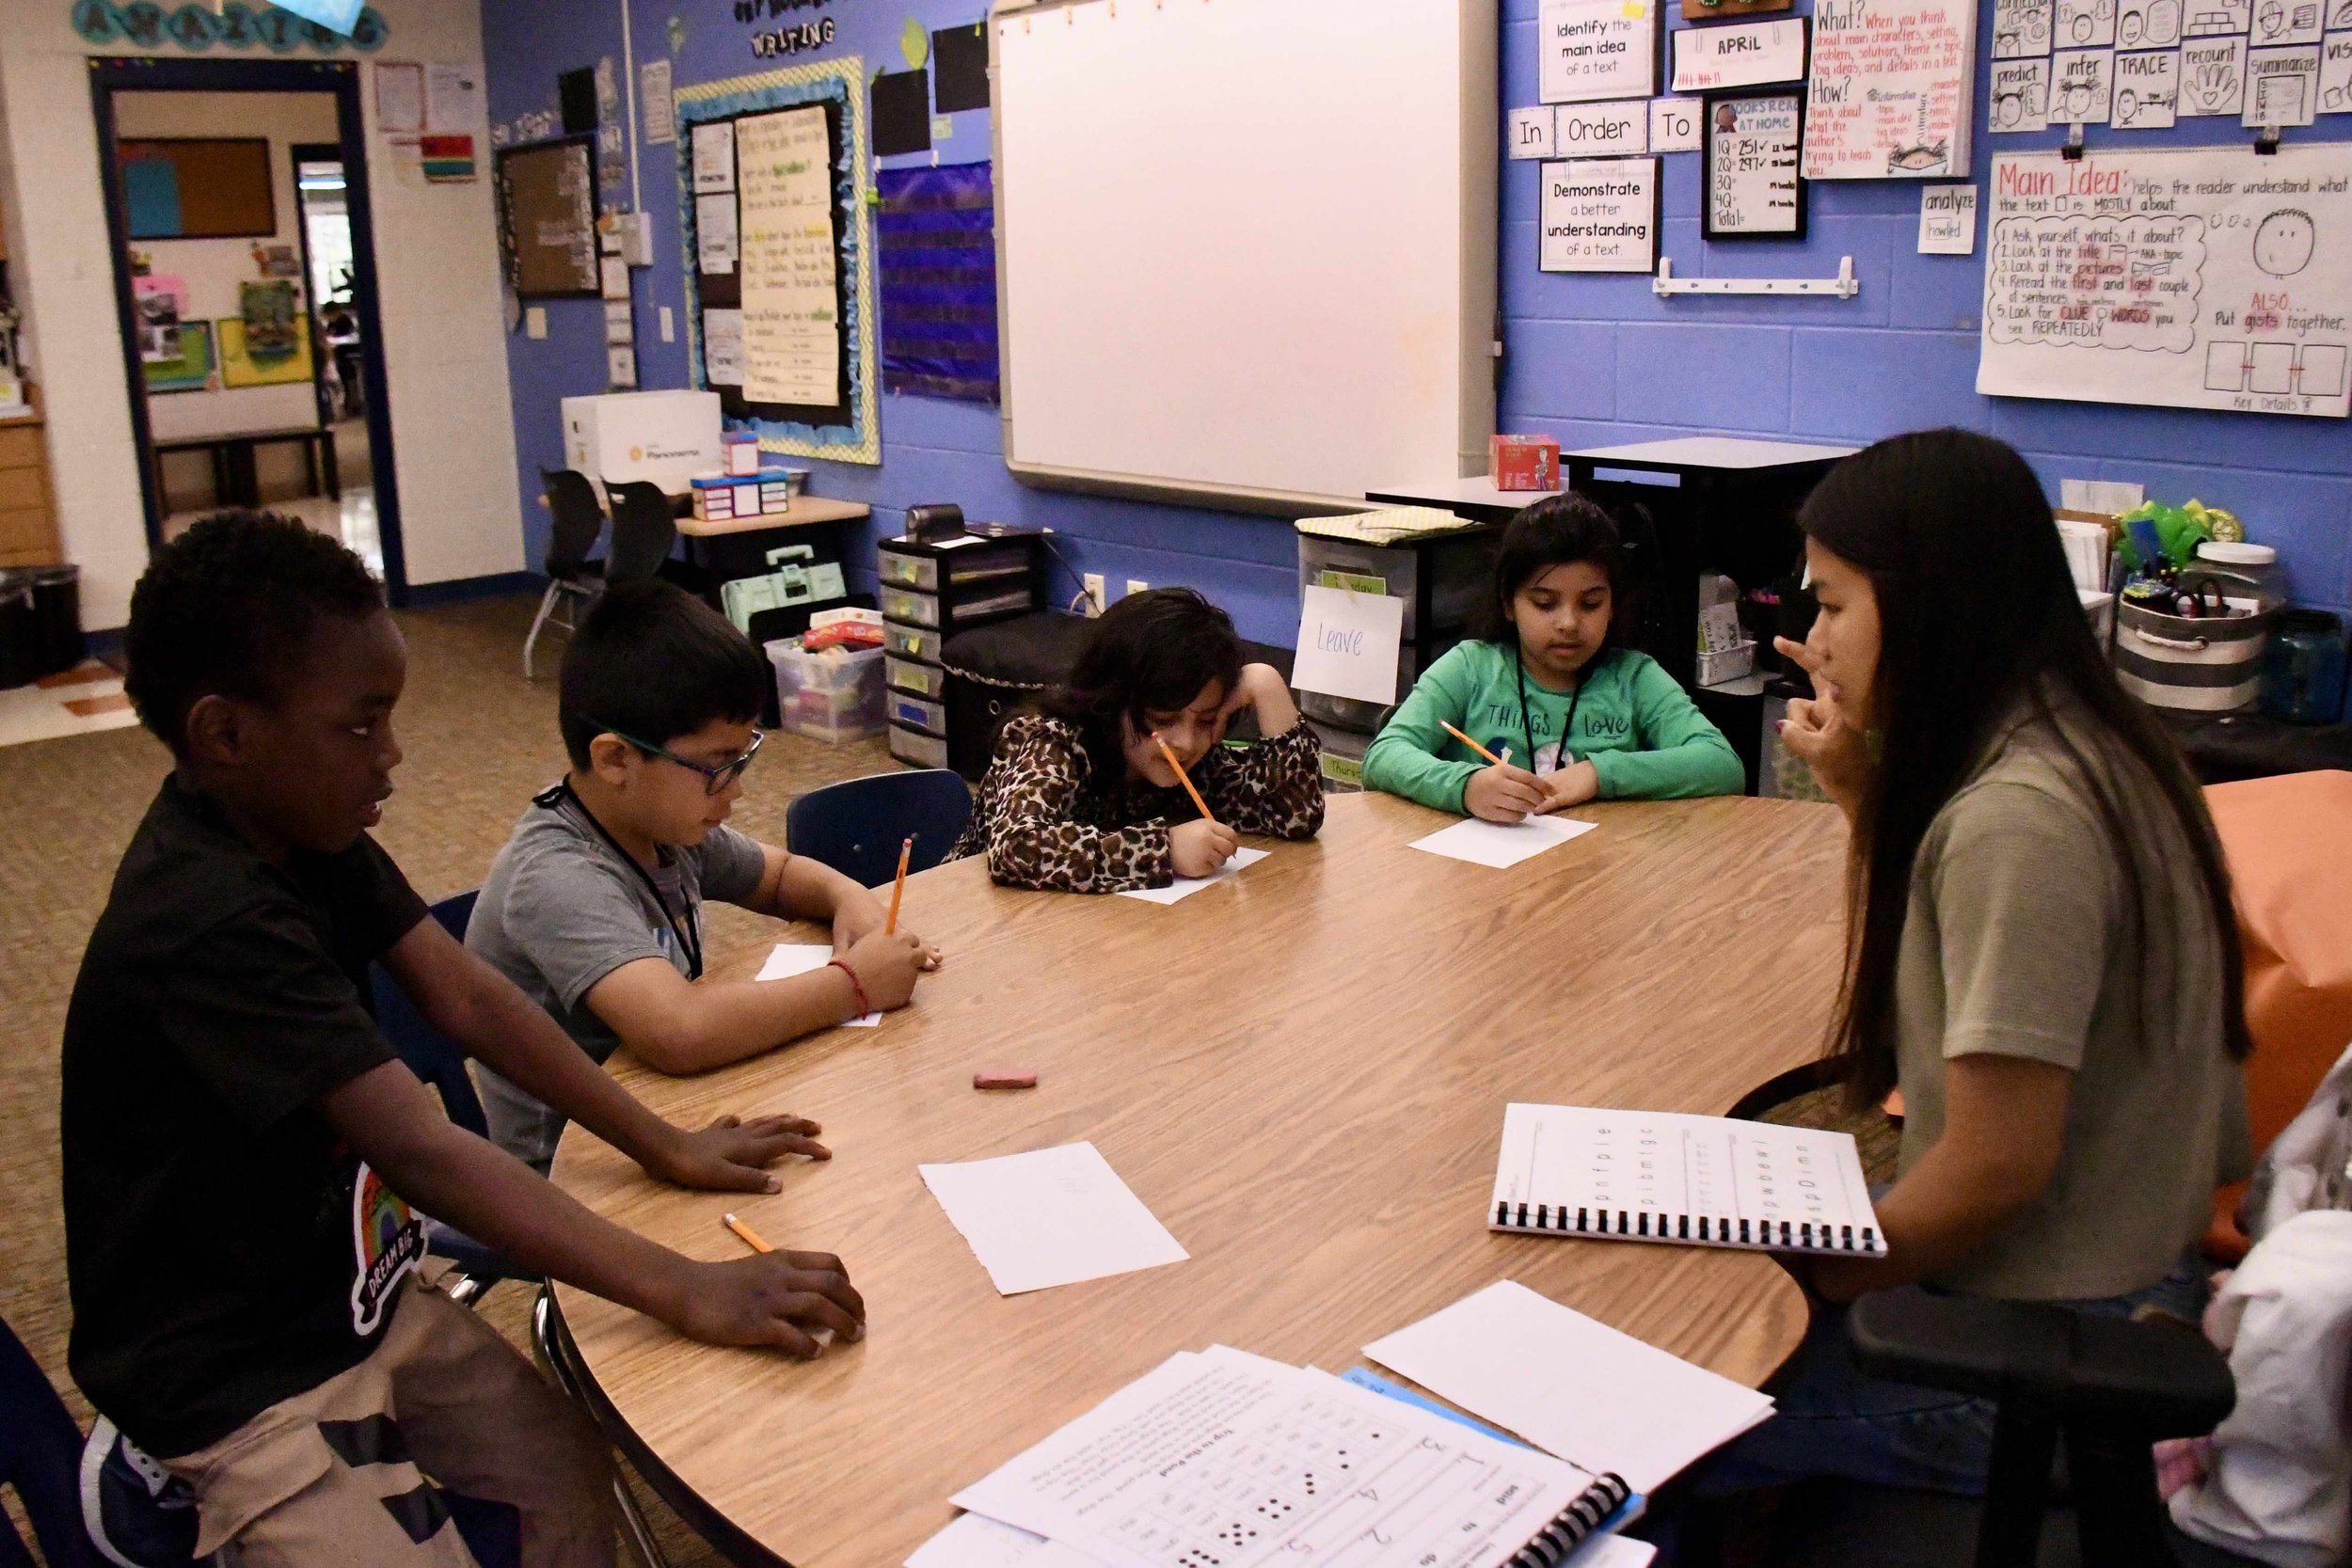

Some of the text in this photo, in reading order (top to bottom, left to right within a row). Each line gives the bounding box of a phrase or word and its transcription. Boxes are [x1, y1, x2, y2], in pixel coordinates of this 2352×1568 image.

[1818, 0, 1865, 32] What?
[1865, 9, 1947, 32] When you think
[751, 17, 835, 58] WRITING
[1557, 19, 1631, 38] Identify the
[1814, 31, 1840, 46] about
[1562, 40, 1626, 58] main idea
[2186, 41, 2236, 64] recount
[1565, 60, 1618, 75] of a text
[1816, 64, 1830, 81] big
[1865, 60, 1883, 73] and
[1887, 58, 1919, 72] details
[1921, 56, 1931, 66] in
[2066, 55, 2102, 77] infer
[2119, 55, 2169, 75] TRACE
[2250, 57, 2316, 75] summarize
[1997, 64, 2038, 88] predict
[1812, 75, 1851, 103] How?
[1808, 103, 1862, 119] Think about
[1520, 113, 1690, 145] In Order To
[1806, 119, 1846, 133] what the
[1804, 149, 1834, 166] trying
[1837, 150, 1846, 161] to
[1554, 181, 1641, 198] Demonstrate
[1999, 162, 2054, 197] Main
[2132, 177, 2163, 201] helps
[2172, 178, 2190, 196] the
[2196, 178, 2237, 196] reader
[2243, 177, 2311, 196] understand
[2318, 176, 2348, 194] what
[1571, 203, 1620, 216] a better
[1925, 188, 1974, 214] analyze
[2000, 196, 2177, 214] the text is MOSTLY about
[1548, 222, 1646, 239] understanding
[2011, 229, 2031, 243] Ask
[2127, 228, 2135, 243] it
[2143, 226, 2185, 243] about?
[1566, 243, 1579, 256] of
[1582, 245, 1591, 256] a
[2012, 245, 2035, 259] Look
[2040, 246, 2051, 258] at
[2056, 245, 2074, 258] the
[2010, 260, 2033, 273] Look
[2038, 261, 2049, 273] at
[2057, 261, 2073, 275] the
[2075, 261, 2124, 280] pictures
[2010, 275, 2045, 289] Reread
[2051, 276, 2068, 290] the
[2073, 277, 2098, 292] first
[2103, 277, 2124, 292] and
[2130, 277, 2153, 292] last
[2160, 278, 2189, 297] couple
[2009, 292, 2019, 303] of
[2009, 306, 2031, 319] Look
[2038, 307, 2053, 320] for
[2058, 307, 2090, 321] CLUE
[2109, 309, 2150, 322] WORDS
[2154, 314, 2174, 329] you
[2215, 310, 2346, 338] Put gists together.
[2032, 321, 2104, 337] REPEATEDLY
[2233, 397, 2297, 412] Key Details
[1317, 621, 1364, 657] Leave
[369, 1227, 414, 1298] DREAM BIG
[1159, 1428, 1234, 1477] Trip to the Pond
[1499, 1484, 1518, 1505] said
[1462, 1522, 1477, 1532] to
[1419, 1554, 1438, 1567] do
